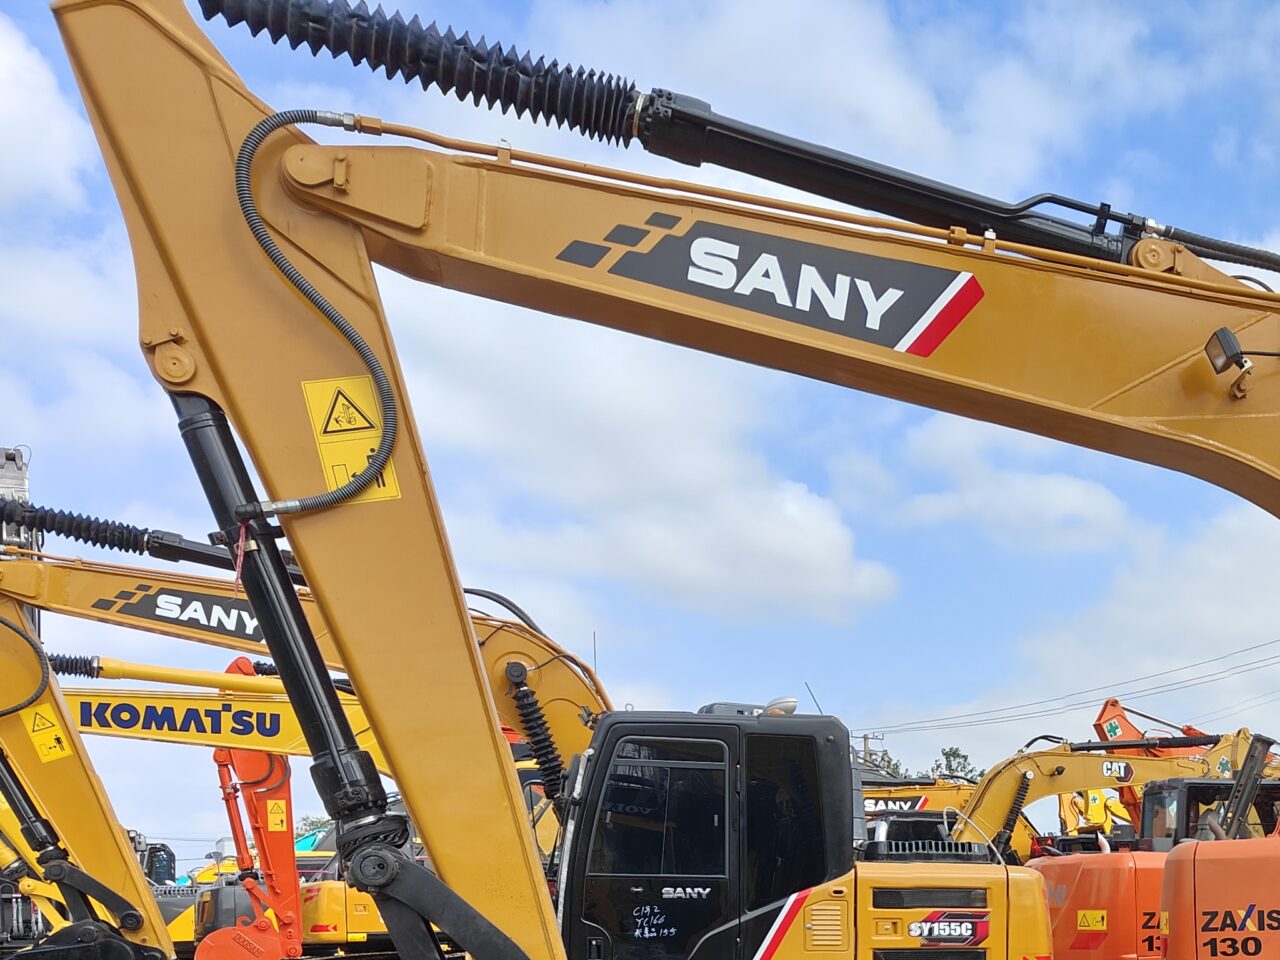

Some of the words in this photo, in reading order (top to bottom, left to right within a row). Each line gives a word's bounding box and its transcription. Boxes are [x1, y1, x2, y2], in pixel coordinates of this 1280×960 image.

[687, 236, 905, 331] SANY
[155, 594, 259, 635] SANY
[79, 701, 281, 738] KOMATSU
[1102, 761, 1127, 777] CAT
[661, 887, 711, 899] SANY
[908, 921, 973, 937] SY155C
[1202, 936, 1262, 957] 130
